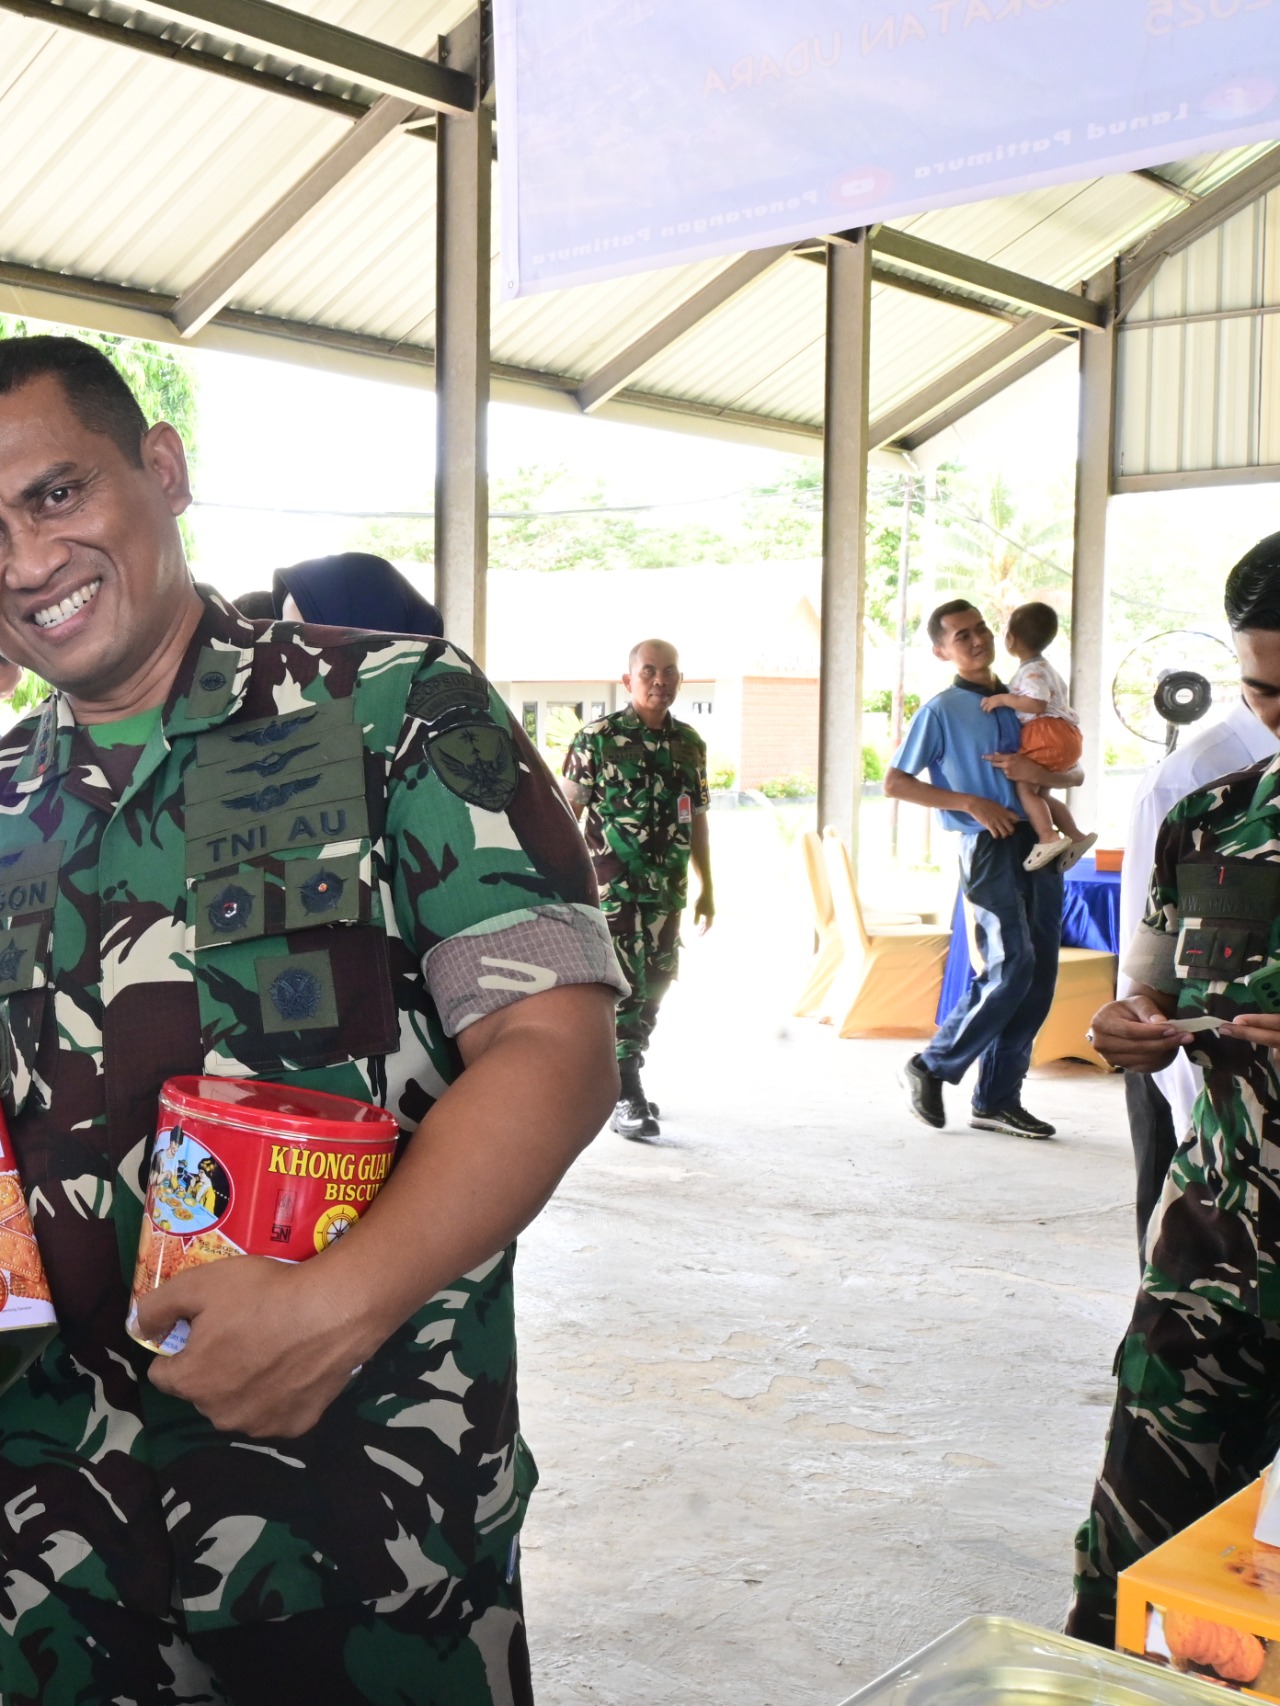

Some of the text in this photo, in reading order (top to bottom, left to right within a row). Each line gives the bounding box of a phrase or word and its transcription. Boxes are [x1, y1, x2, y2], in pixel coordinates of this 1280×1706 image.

[206, 809, 348, 862] TNI AU
[268, 1144, 355, 1181] KHONG
